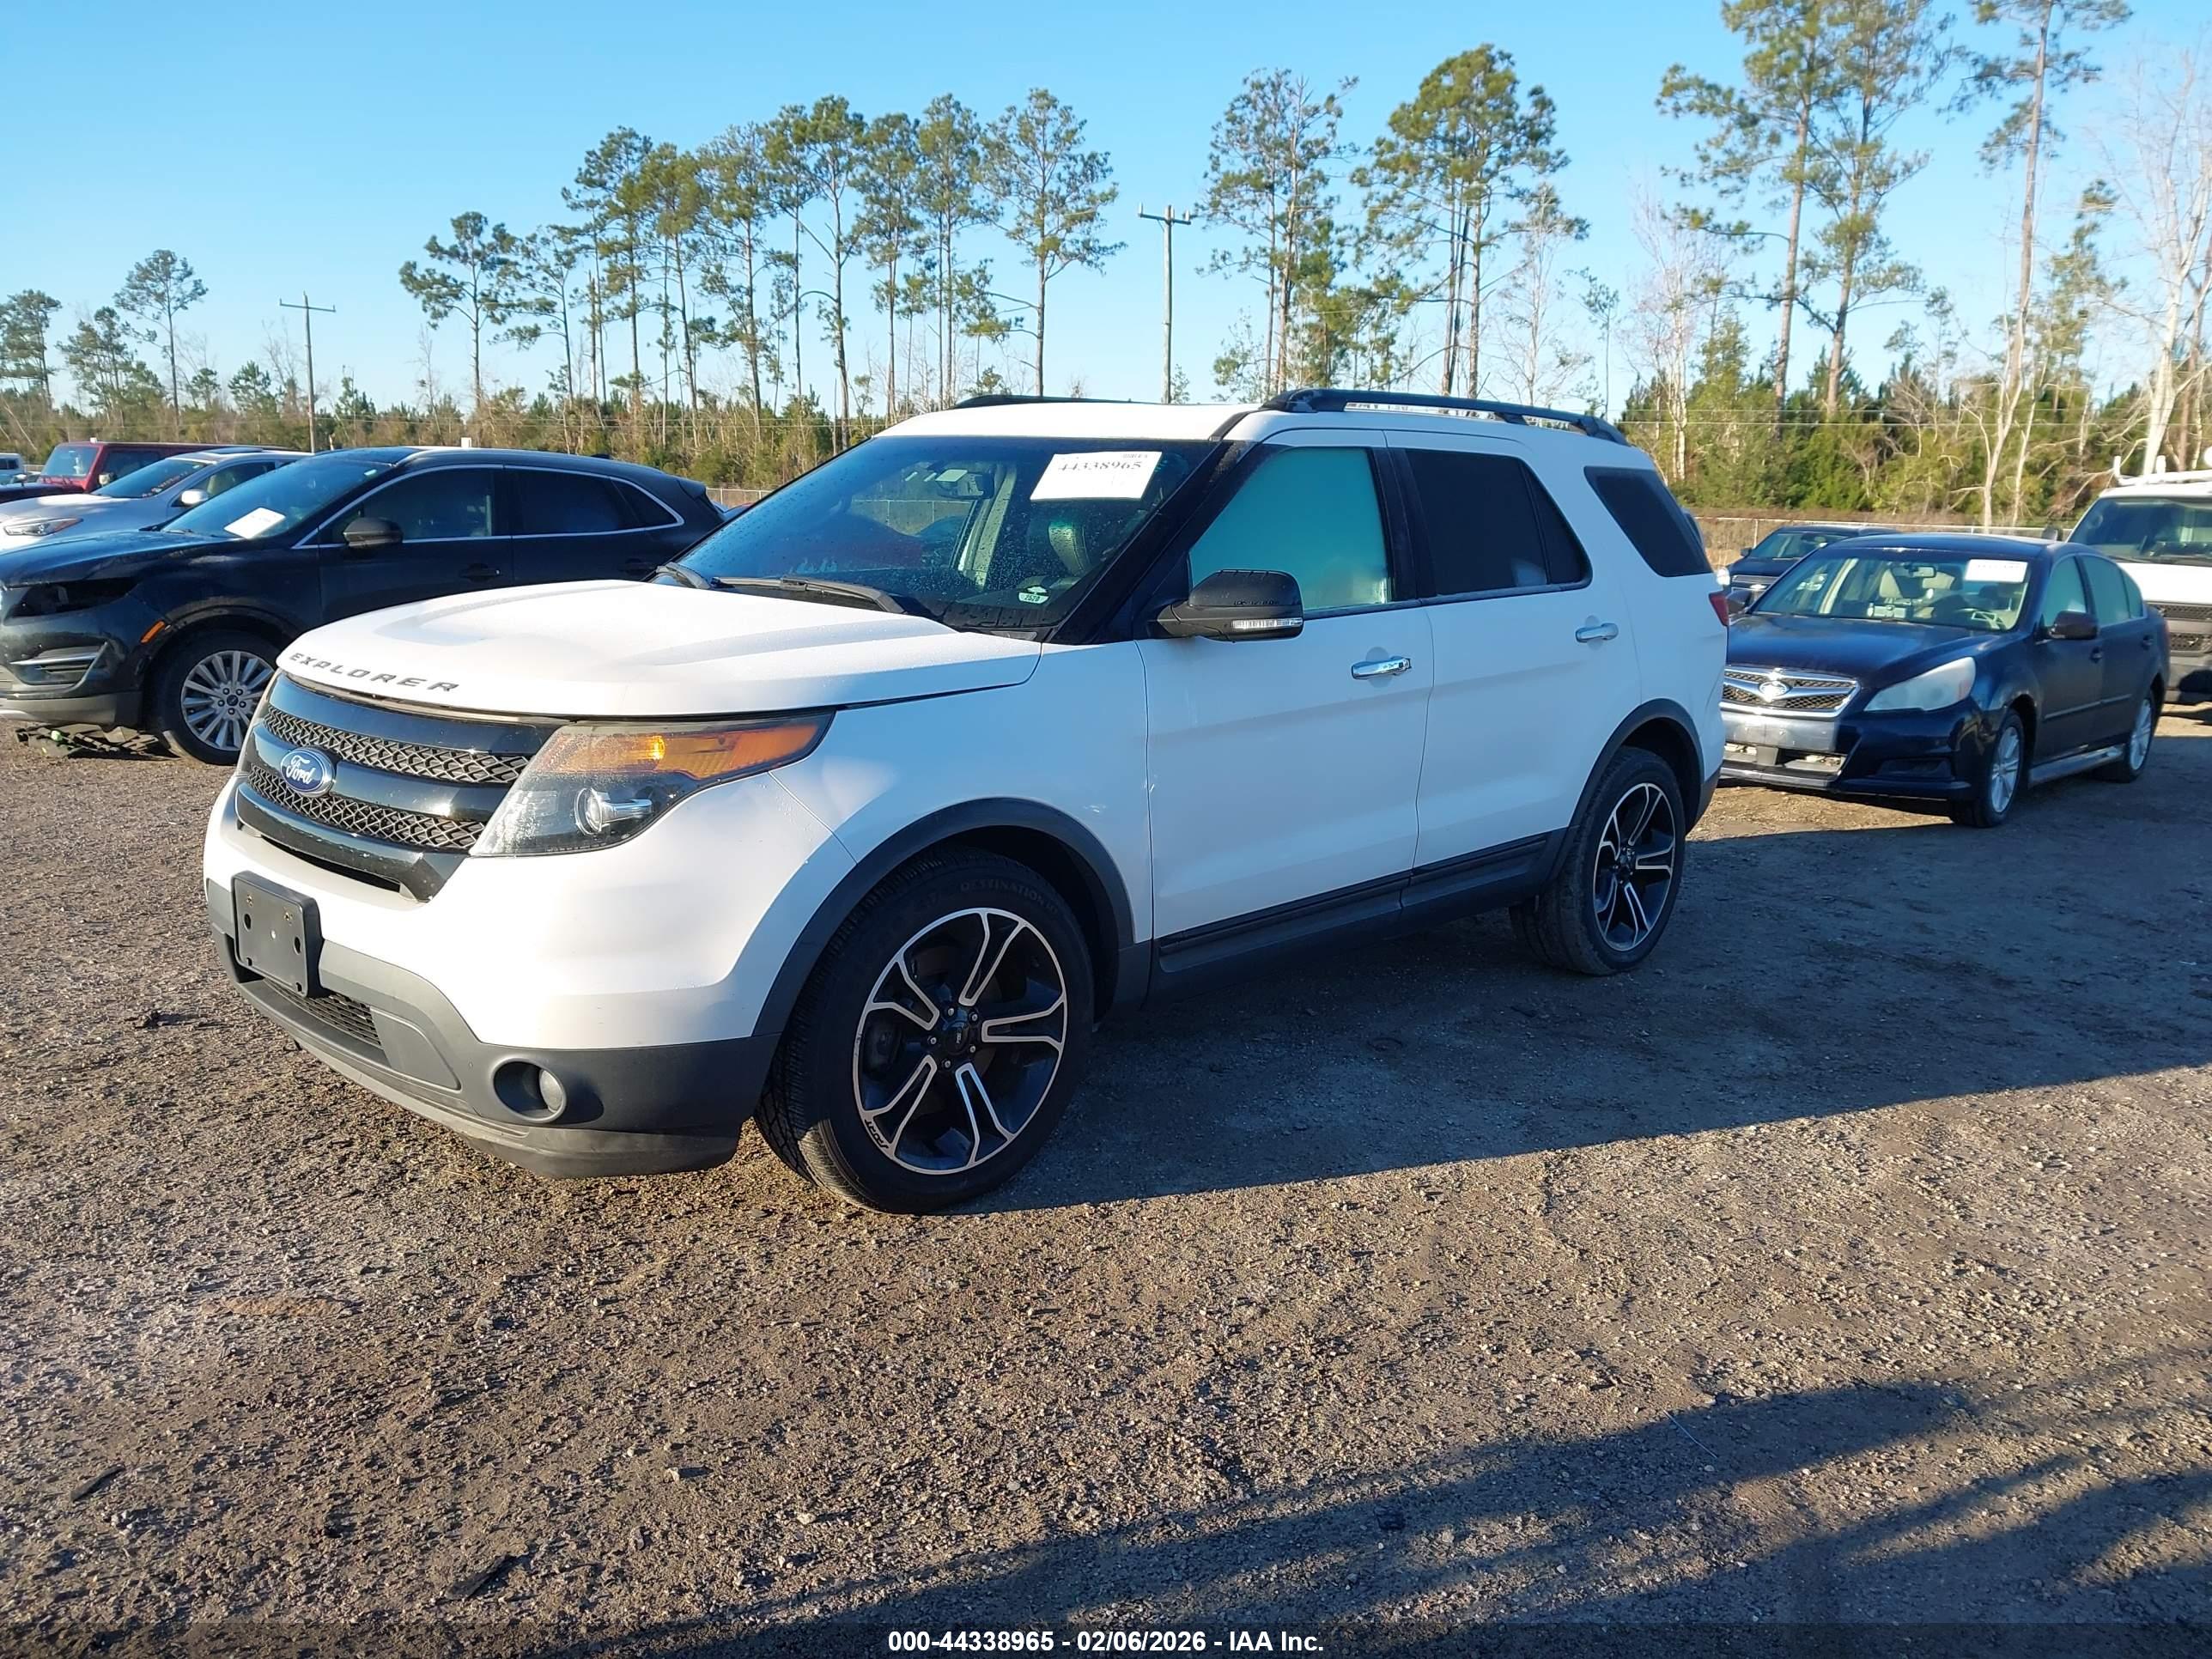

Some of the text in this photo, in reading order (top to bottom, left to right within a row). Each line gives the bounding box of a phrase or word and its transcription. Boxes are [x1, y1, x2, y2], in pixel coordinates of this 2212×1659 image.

[1056, 460, 1143, 471] 44338965
[289, 653, 460, 692] EXPLORER
[285, 755, 316, 784] Ford
[864, 1118, 890, 1149] SPORT
